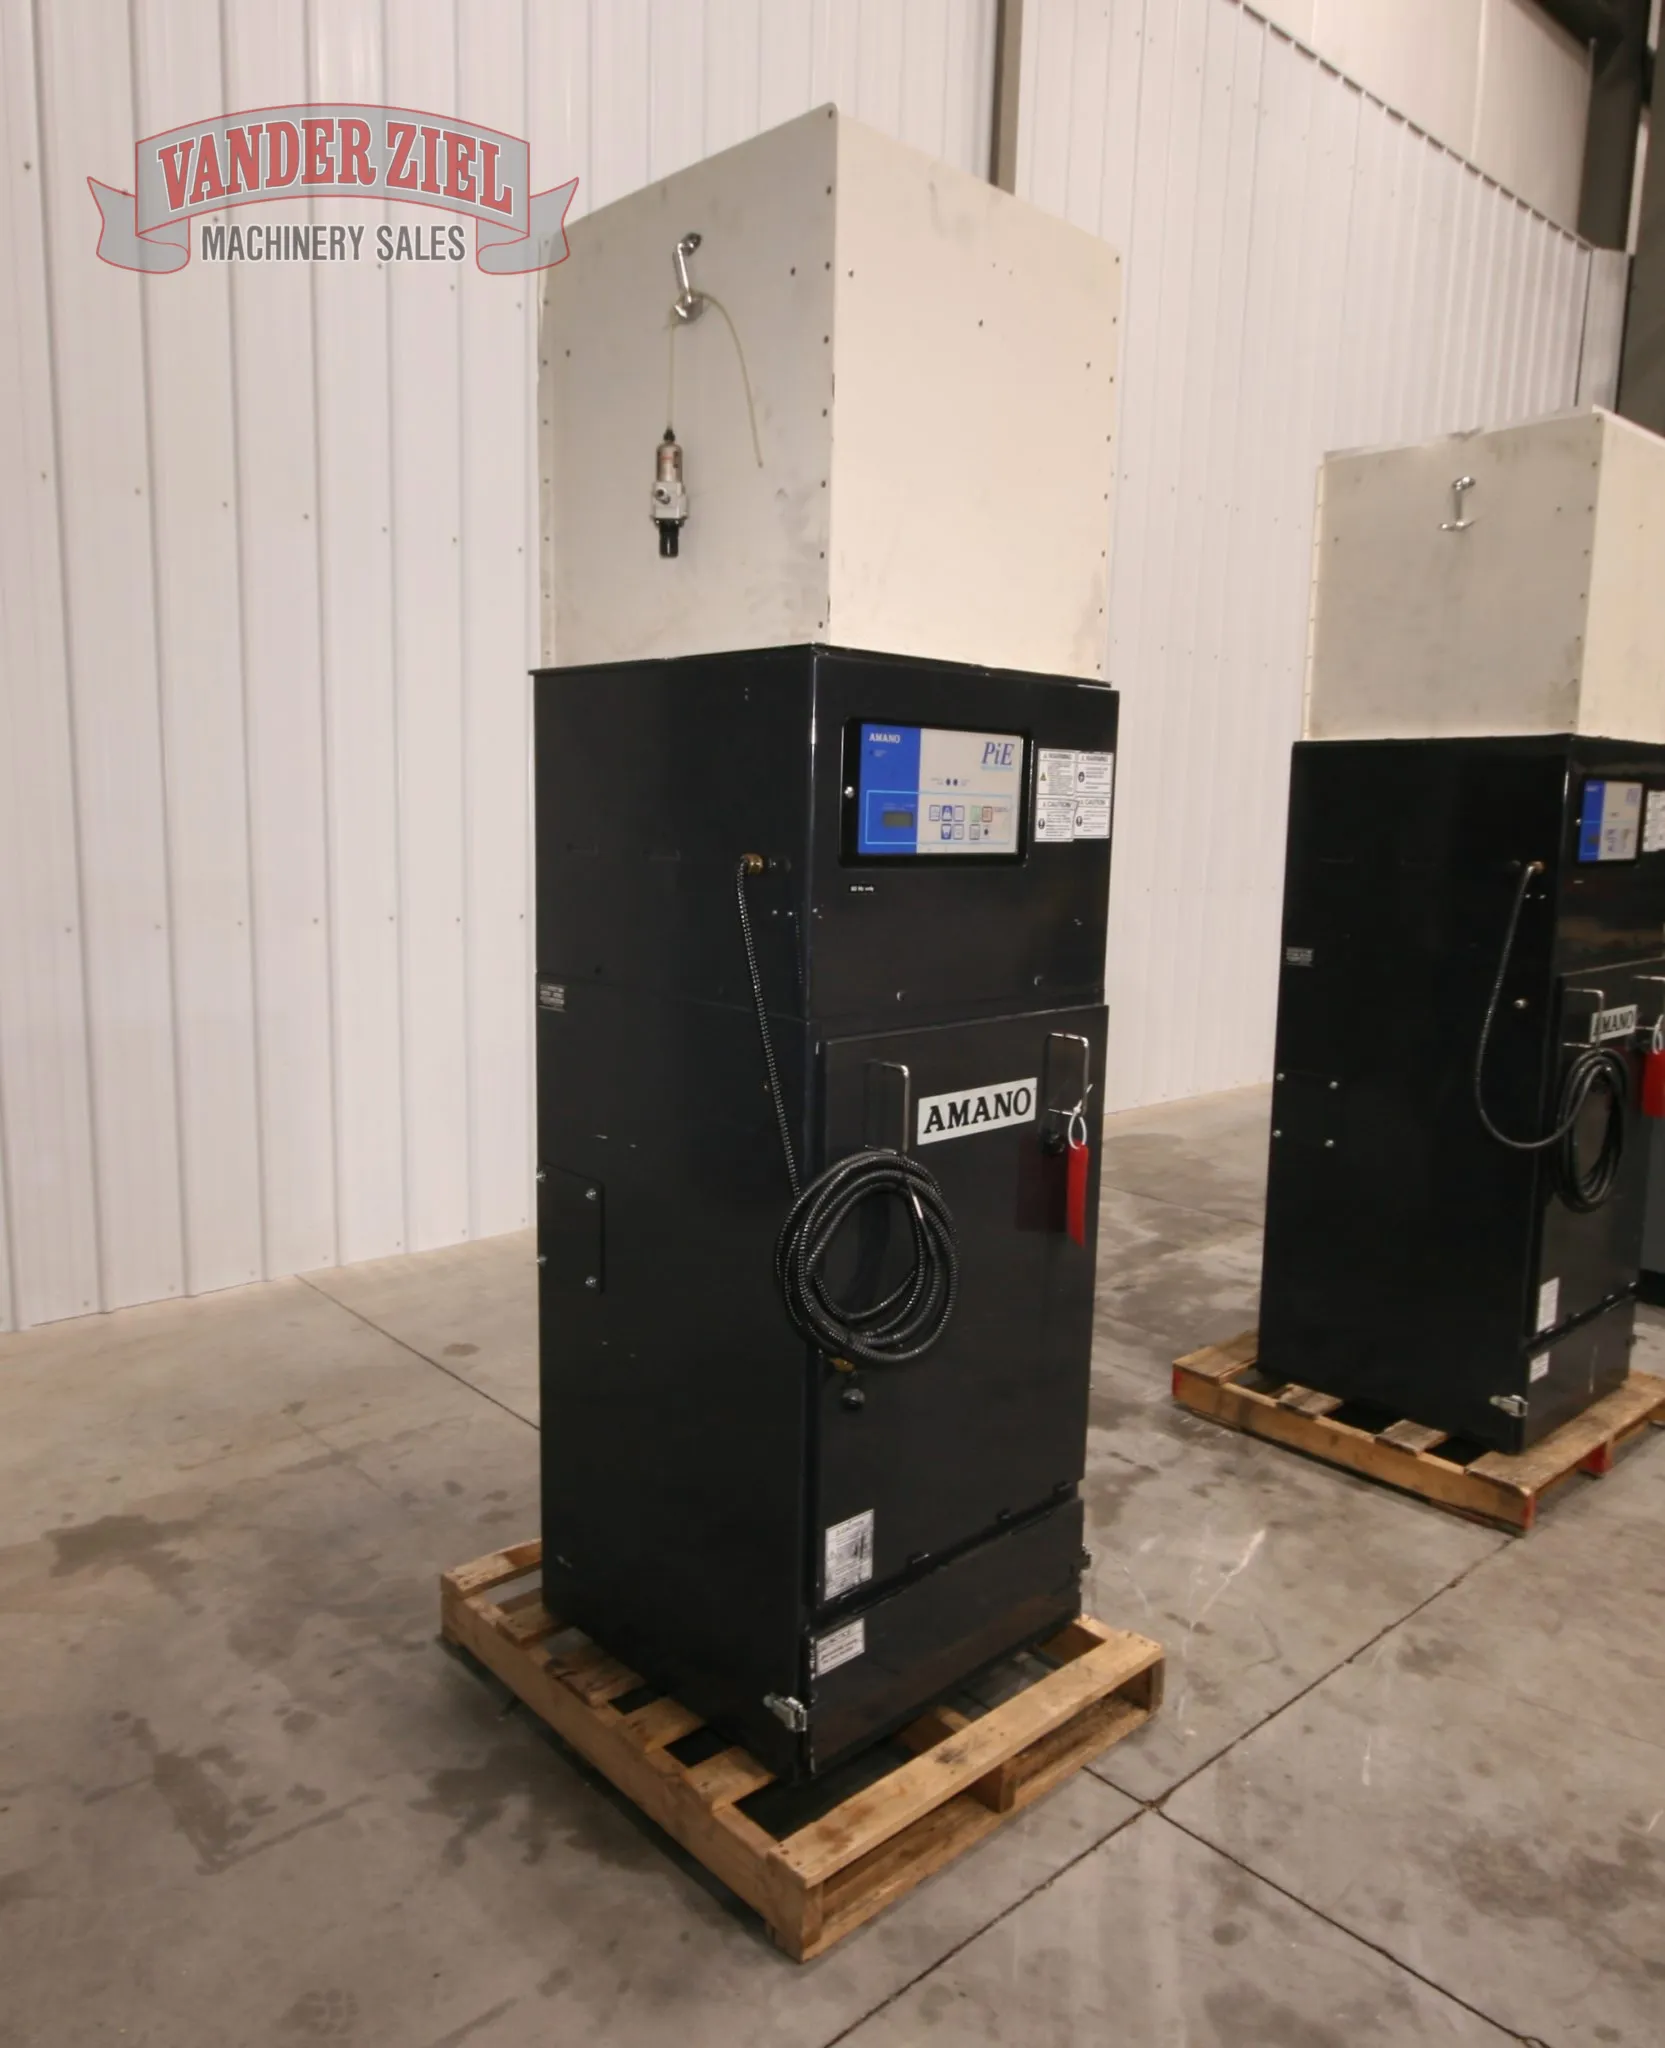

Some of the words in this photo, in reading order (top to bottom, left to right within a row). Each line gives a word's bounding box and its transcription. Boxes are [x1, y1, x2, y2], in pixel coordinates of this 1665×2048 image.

[868, 732, 901, 745] AMANO
[981, 741, 1015, 766] PiE
[923, 1087, 1031, 1134] AMANO
